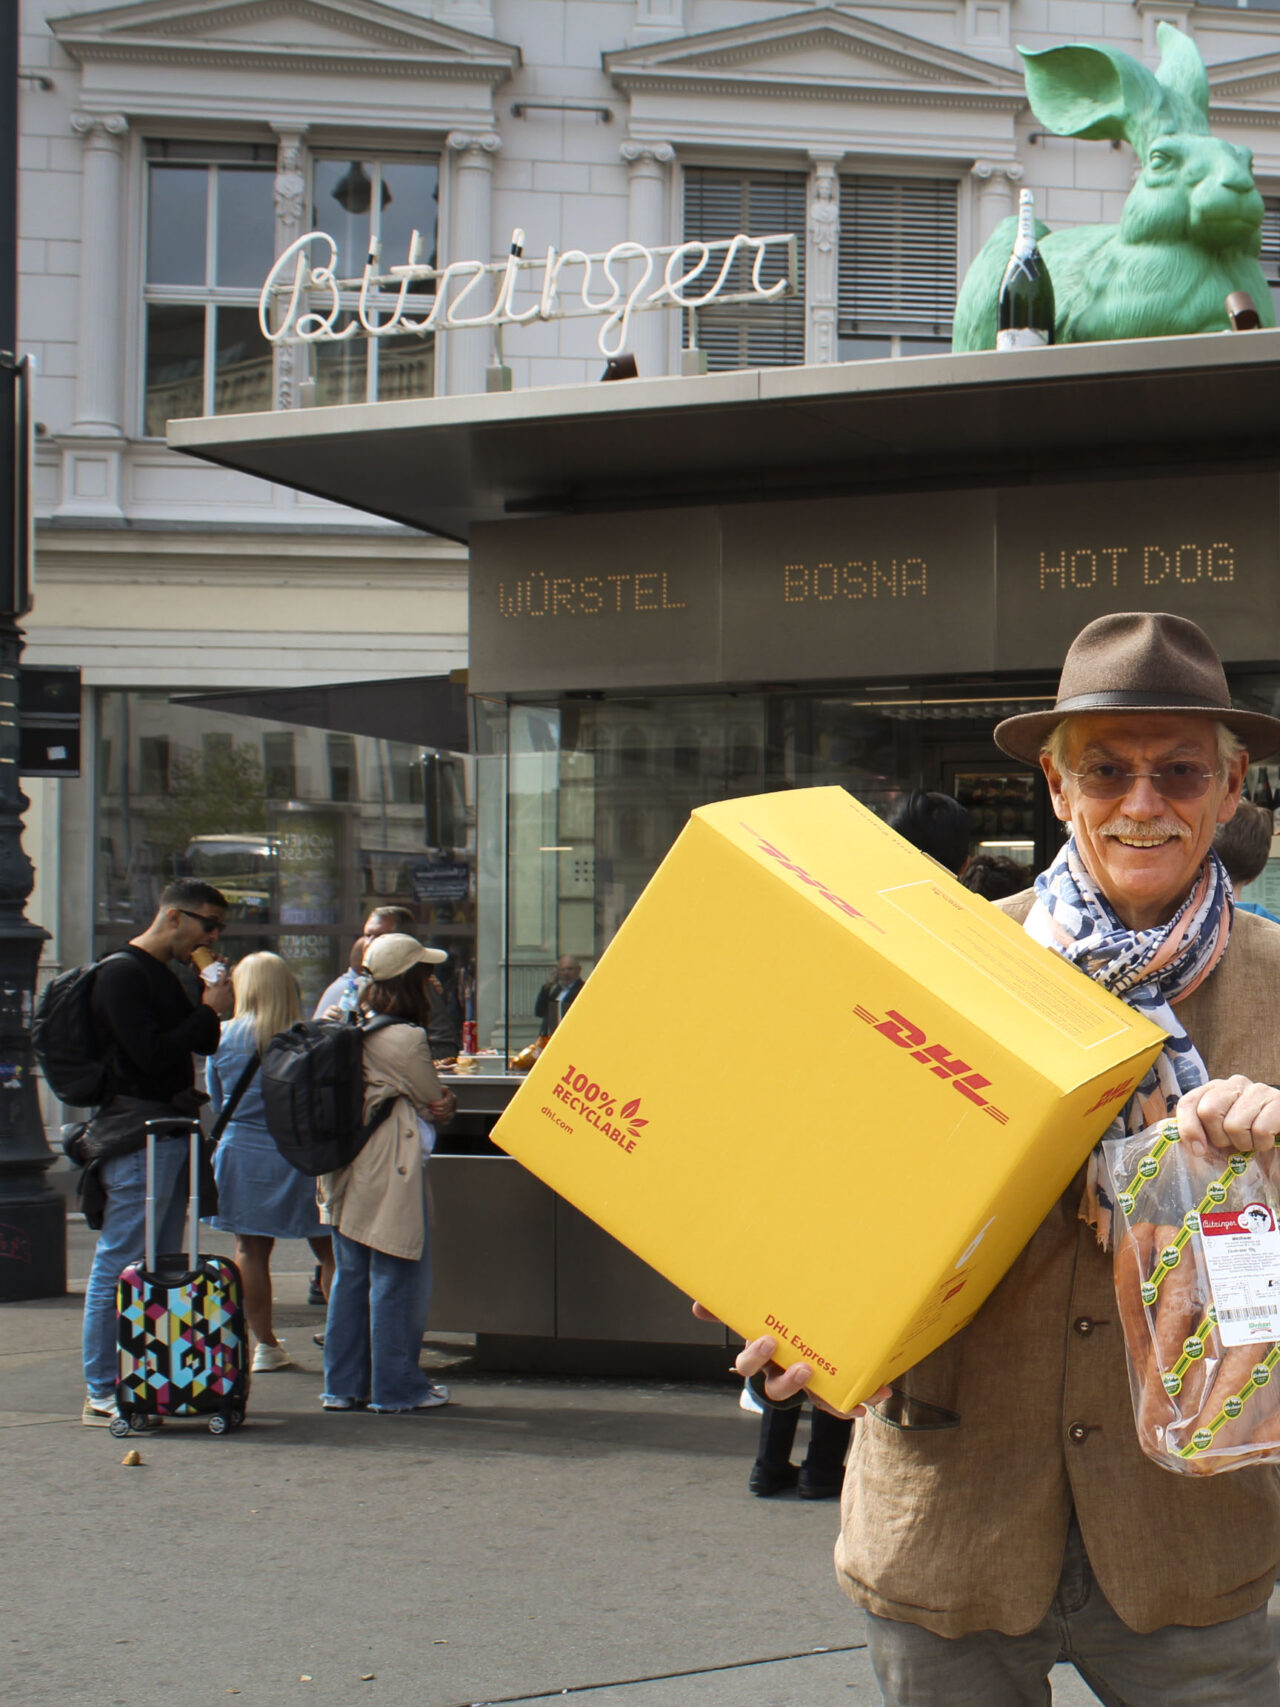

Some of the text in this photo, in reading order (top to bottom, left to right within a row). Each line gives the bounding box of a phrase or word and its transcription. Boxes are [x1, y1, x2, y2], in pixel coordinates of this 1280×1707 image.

[259, 228, 789, 357] Bitzinger
[785, 557, 927, 602] BOSNA
[1040, 542, 1235, 590] HOT DOG
[499, 571, 687, 618] WÜRSTEL
[872, 1009, 993, 1107] DHL
[561, 1064, 617, 1117] 100%
[541, 1106, 574, 1135] dhl.com
[552, 1083, 637, 1154] RECYCLABLE
[764, 1314, 838, 1376] DHL Express
